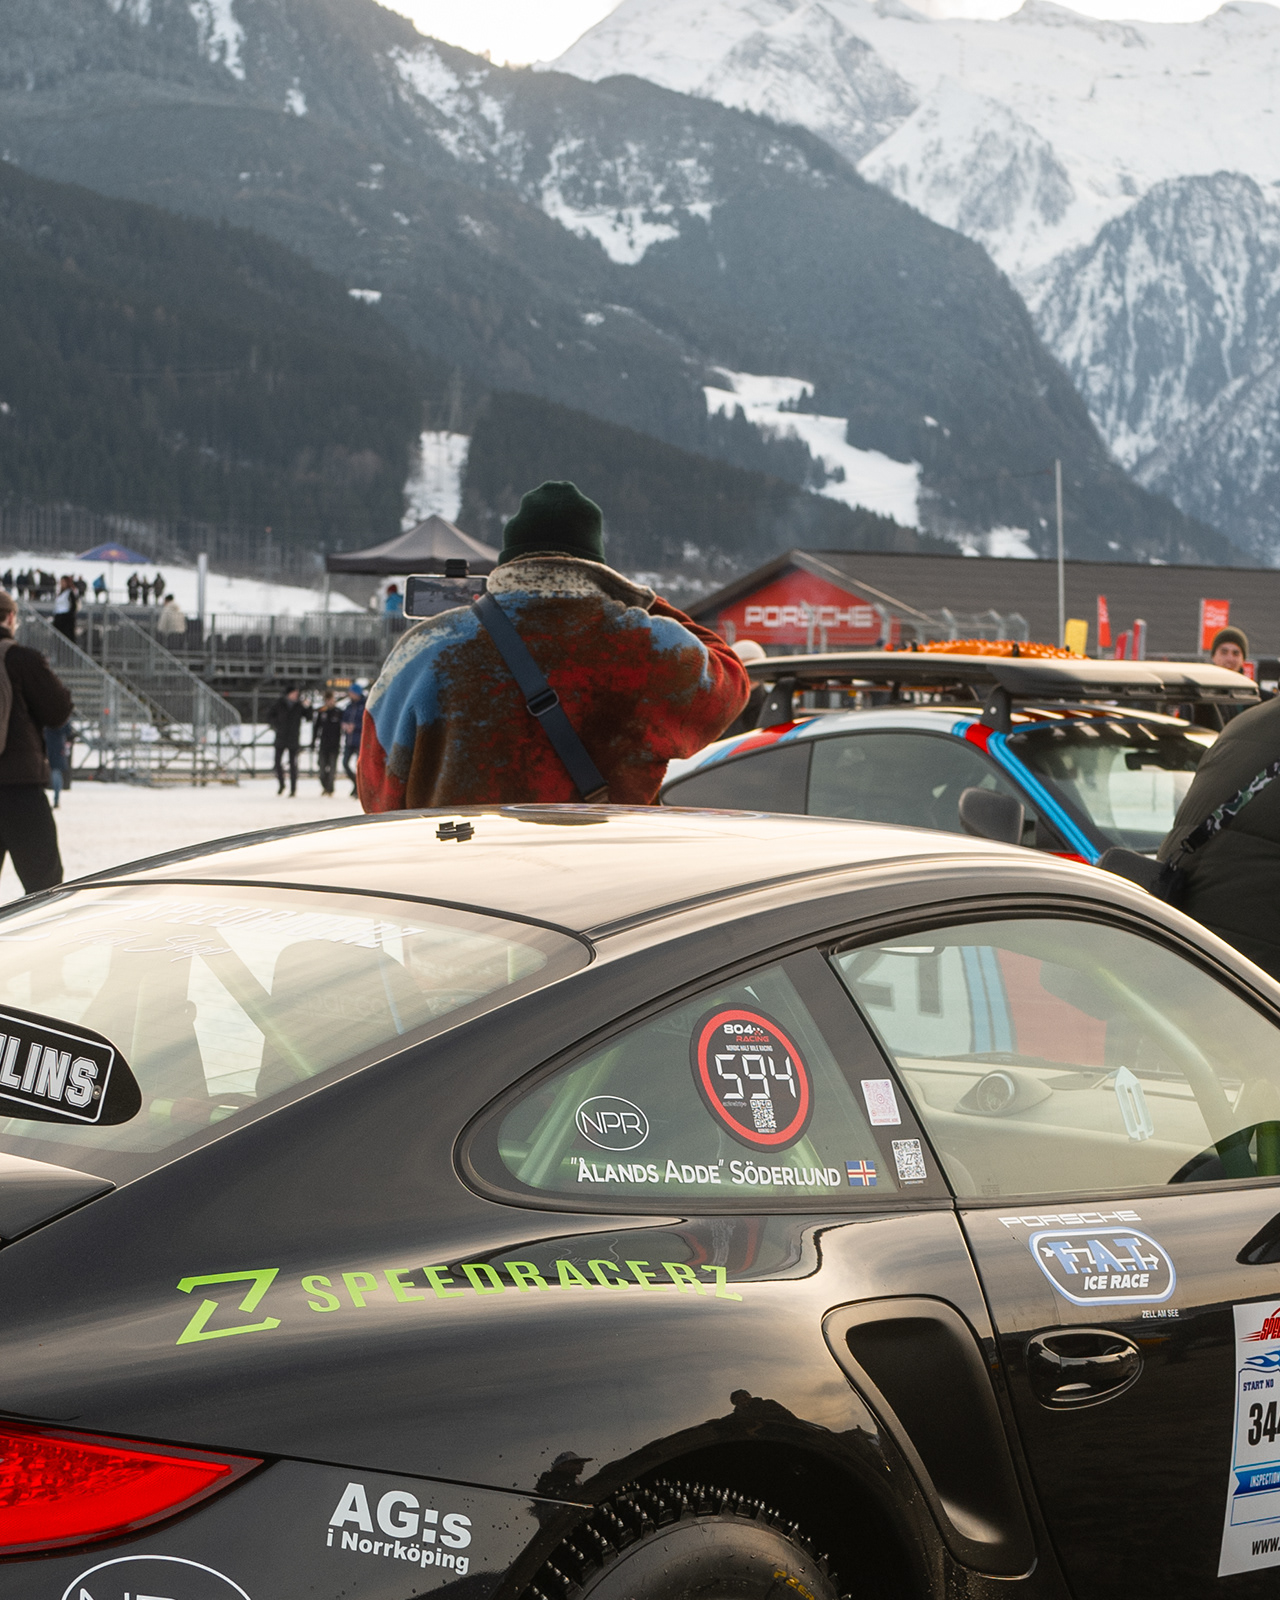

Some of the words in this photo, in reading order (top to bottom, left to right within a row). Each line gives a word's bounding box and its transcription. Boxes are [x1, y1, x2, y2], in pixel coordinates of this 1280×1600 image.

[745, 605, 873, 628] PORSCHE
[723, 1024, 753, 1034] 804
[736, 1035, 770, 1043] RACING
[715, 1054, 797, 1100] 594
[580, 1111, 644, 1136] NPR
[729, 1159, 842, 1186] SÖDERLUND
[997, 1210, 1142, 1229] PORSCHE
[301, 1259, 744, 1313] SPEEDRACERZ
[1084, 1275, 1108, 1290] ICE
[1110, 1273, 1150, 1289] RACE
[1141, 1310, 1157, 1319] ZELL
[1157, 1310, 1167, 1318] AM
[1167, 1309, 1180, 1318] SEE
[1243, 1379, 1264, 1391] START
[1265, 1378, 1274, 1389] NO
[1249, 1471, 1280, 1488] INSPECTION
[329, 1482, 473, 1549] AG:s
[326, 1528, 334, 1547] i
[341, 1531, 470, 1575] Norrköping
